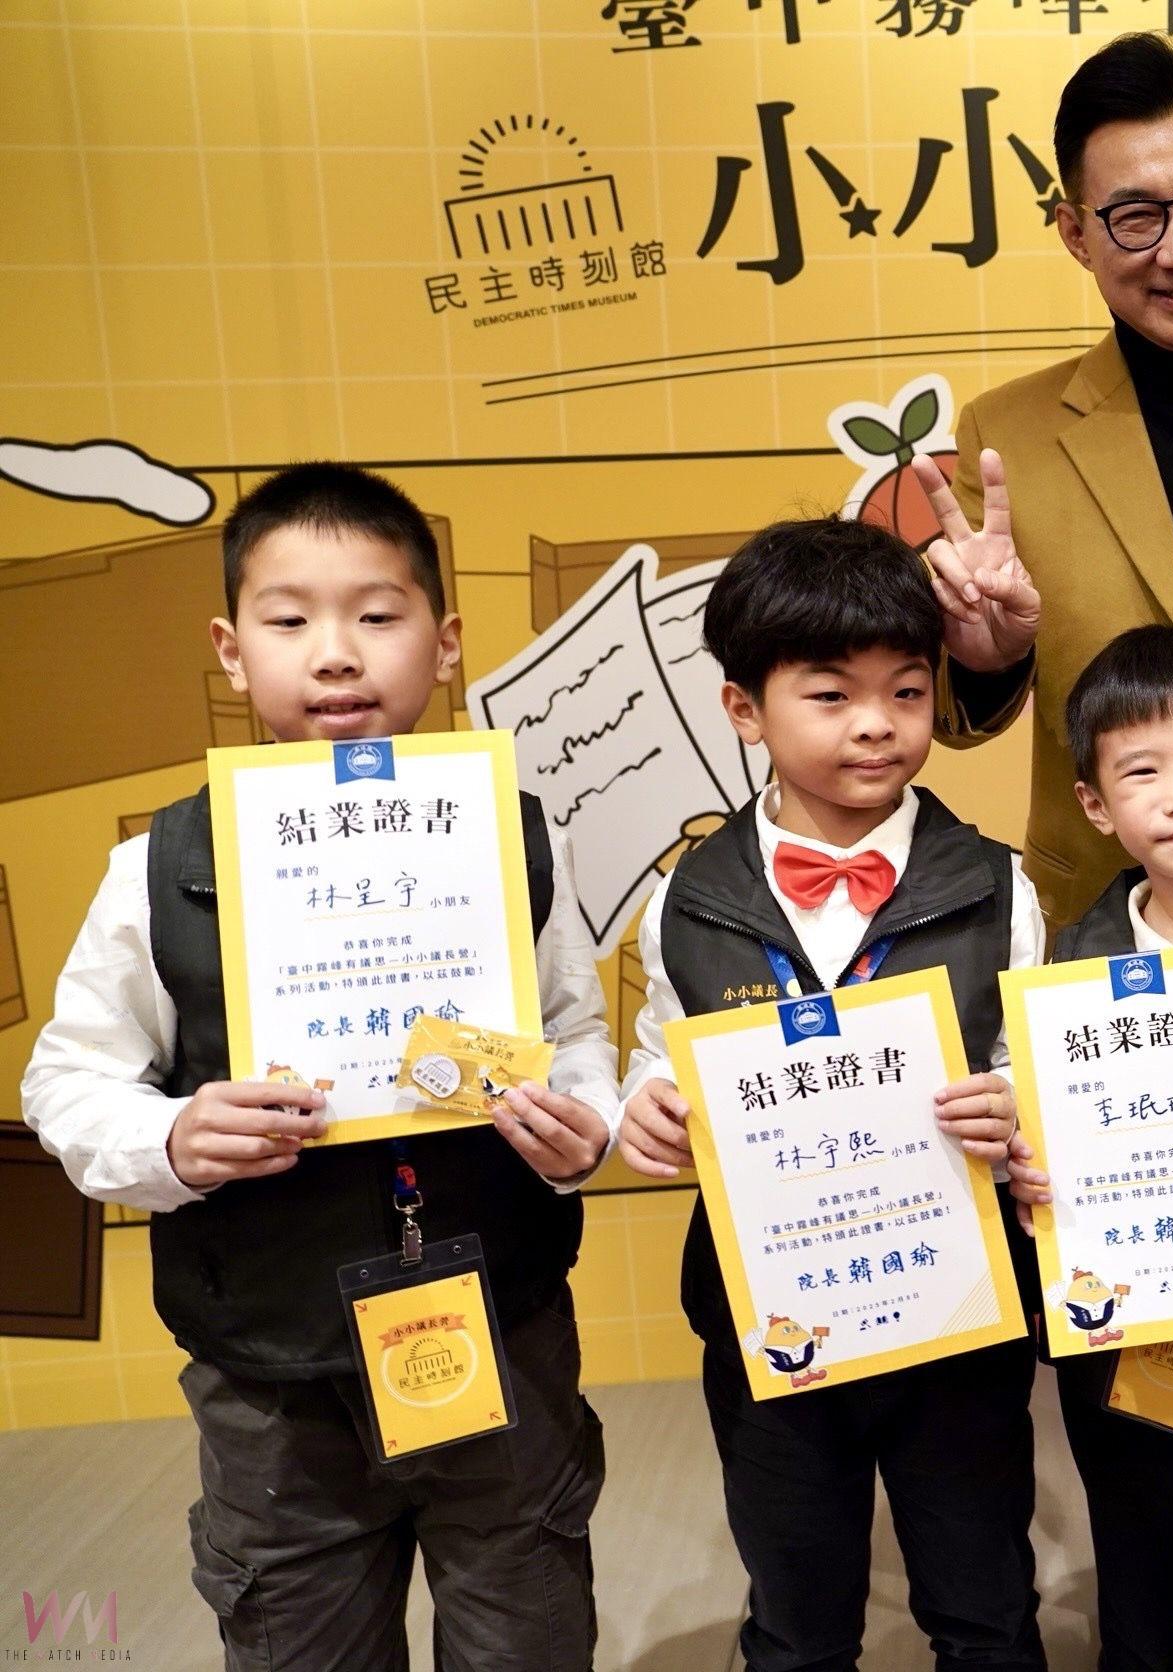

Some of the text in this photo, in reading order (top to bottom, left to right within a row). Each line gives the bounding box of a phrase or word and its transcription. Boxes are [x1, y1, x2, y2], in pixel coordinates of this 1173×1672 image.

[424, 240, 667, 314] 民主時刻館
[473, 292, 637, 328] DEMOCRATIC TIMES MUSEUM
[276, 798, 459, 846] 結業證書
[277, 866, 319, 879] 親愛的
[430, 896, 470, 908] 小朋友
[344, 935, 412, 950] 恭喜你完成
[724, 985, 778, 1001] 小小議長
[737, 1047, 906, 1111] 結業證書
[1068, 1081, 1104, 1095] 親愛的
[746, 1128, 784, 1143] 親愛的
[892, 1140, 929, 1158] 小朋友
[818, 1186, 881, 1207] 恭喜你完成
